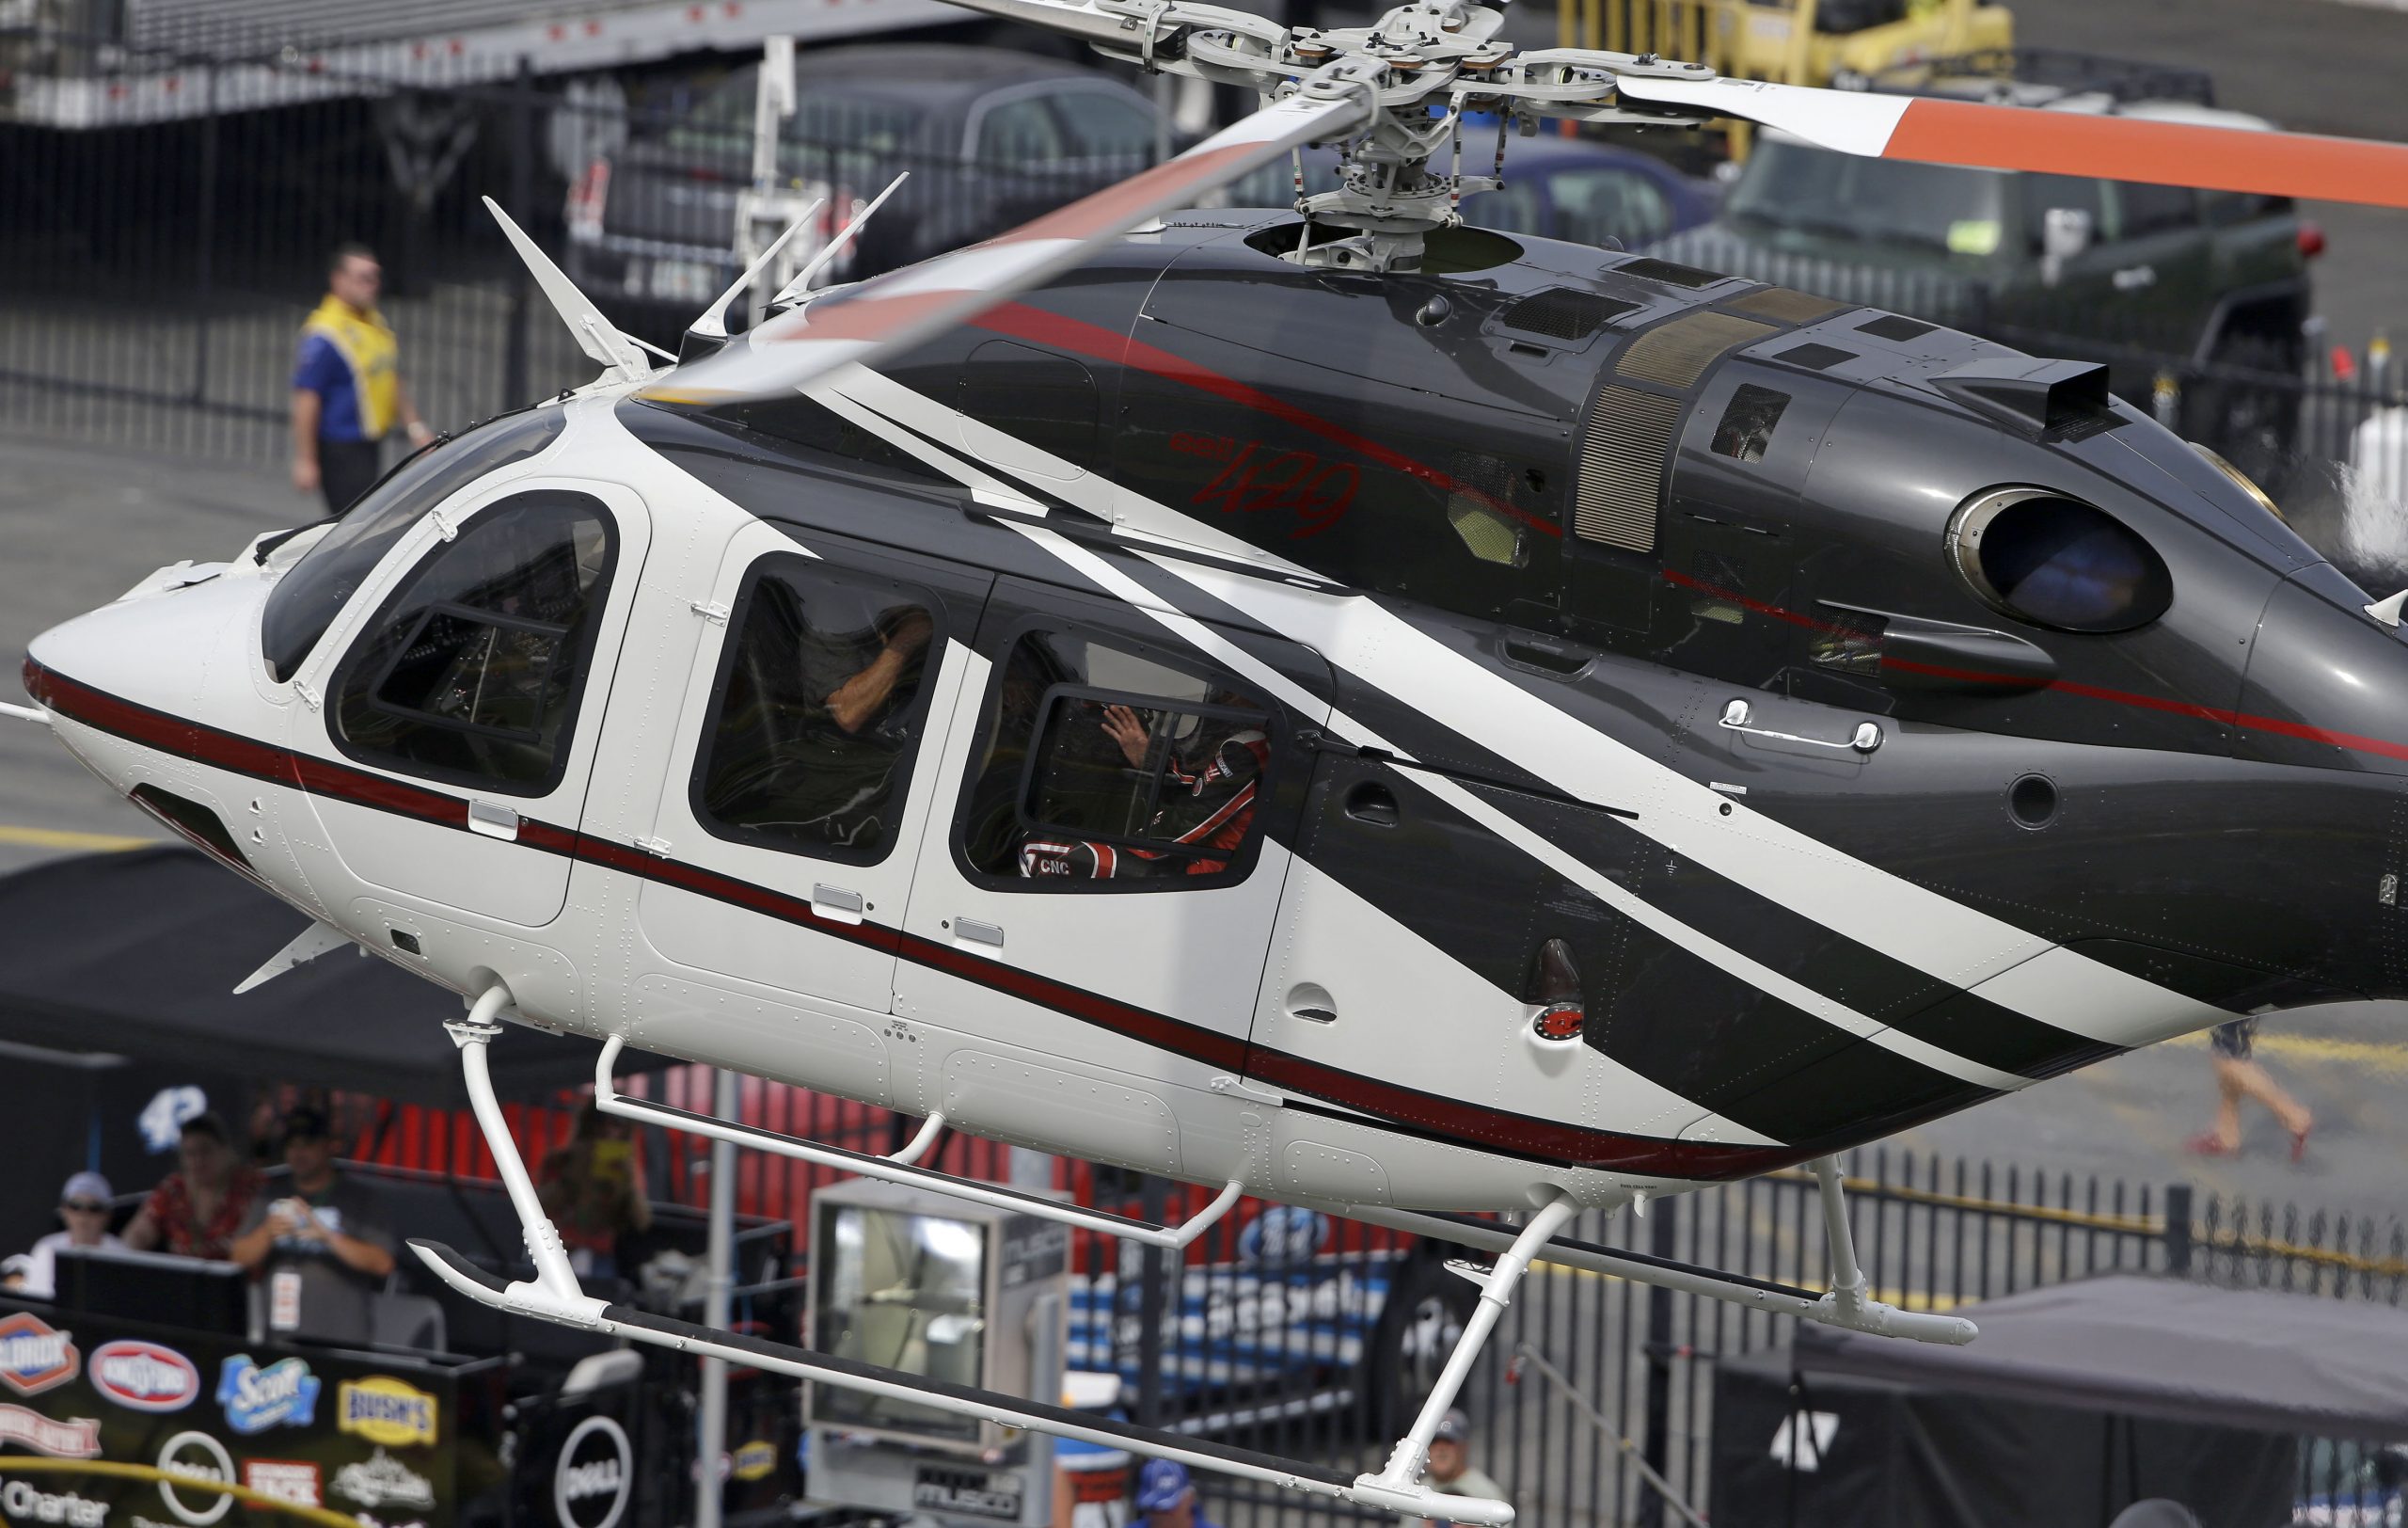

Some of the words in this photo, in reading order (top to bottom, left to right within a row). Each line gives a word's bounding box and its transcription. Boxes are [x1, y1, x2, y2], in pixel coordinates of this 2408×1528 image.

[1191, 439, 1363, 540] 429
[1040, 858, 1069, 875] CNC
[565, 1457, 619, 1499] DELL
